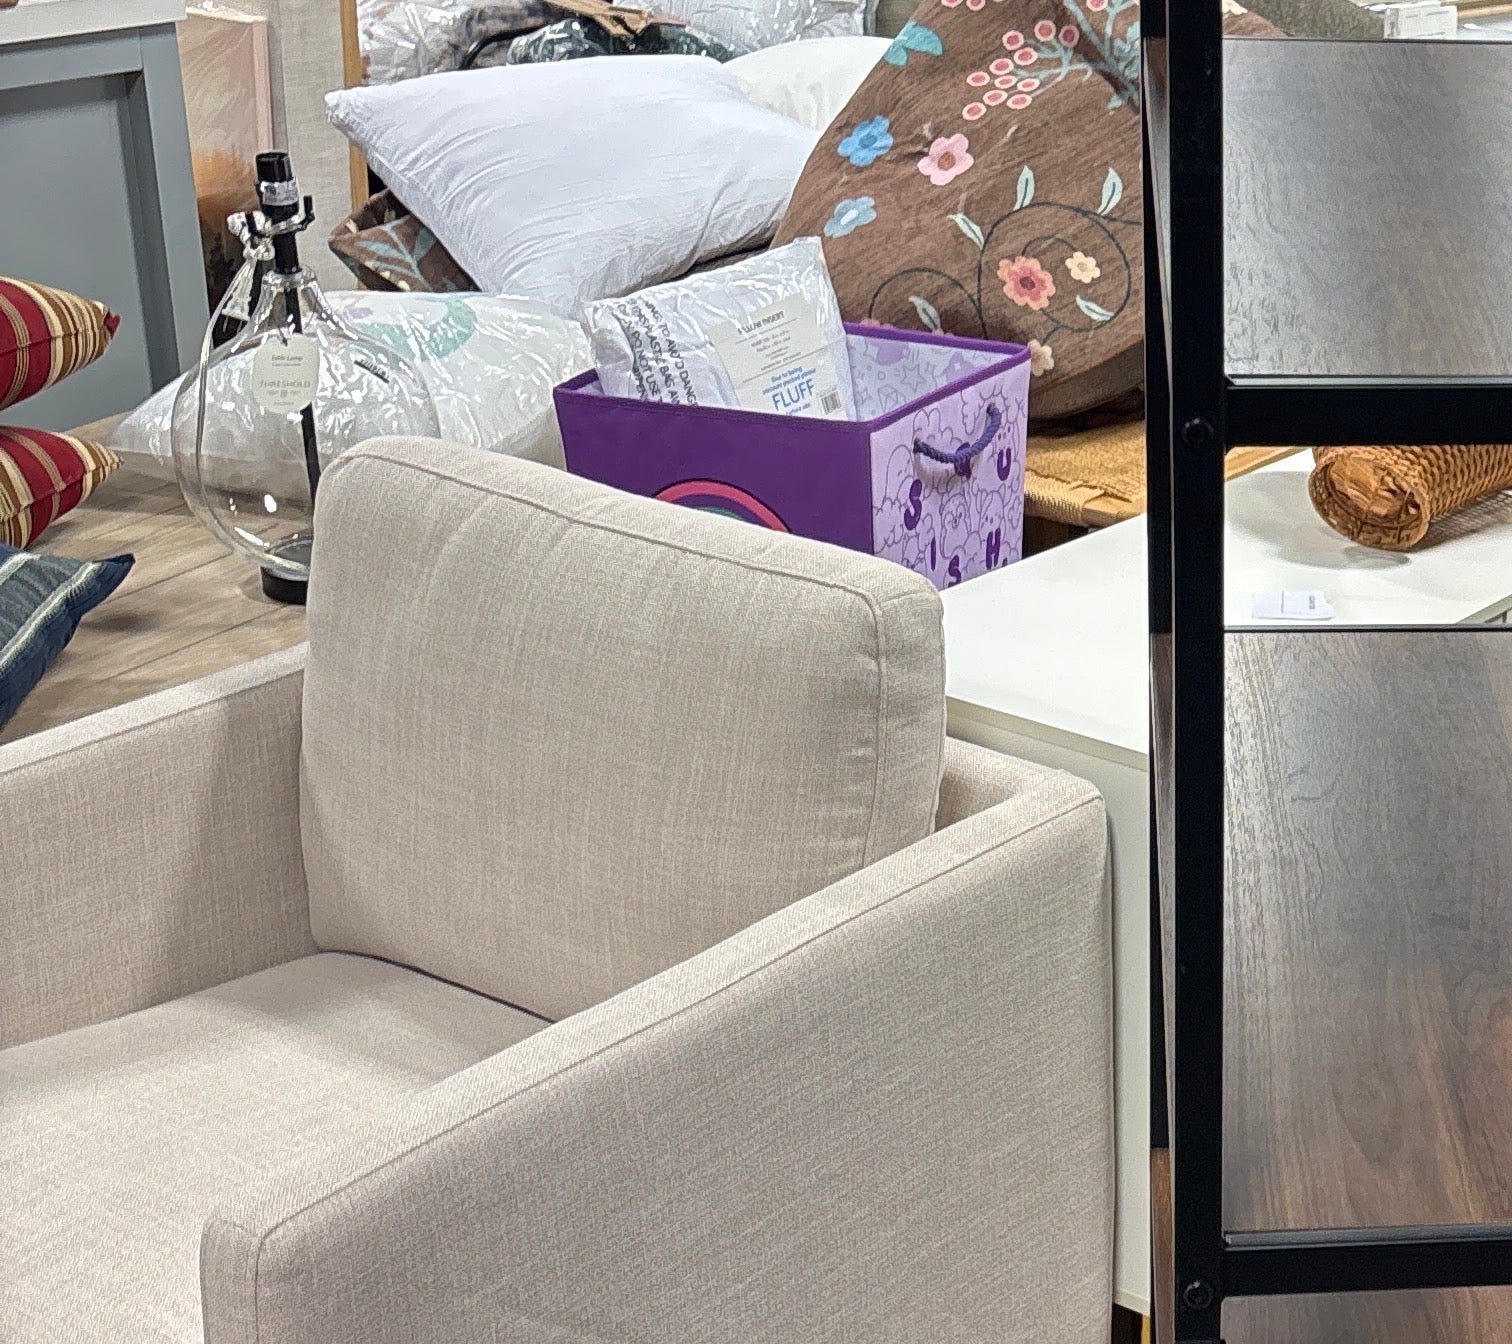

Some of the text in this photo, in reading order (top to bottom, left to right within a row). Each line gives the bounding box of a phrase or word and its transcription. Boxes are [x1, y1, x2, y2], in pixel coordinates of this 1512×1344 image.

[660, 323, 670, 337] TO
[637, 350, 652, 372] NOT
[646, 374, 661, 395] USE
[772, 378, 814, 411] FLUFF
